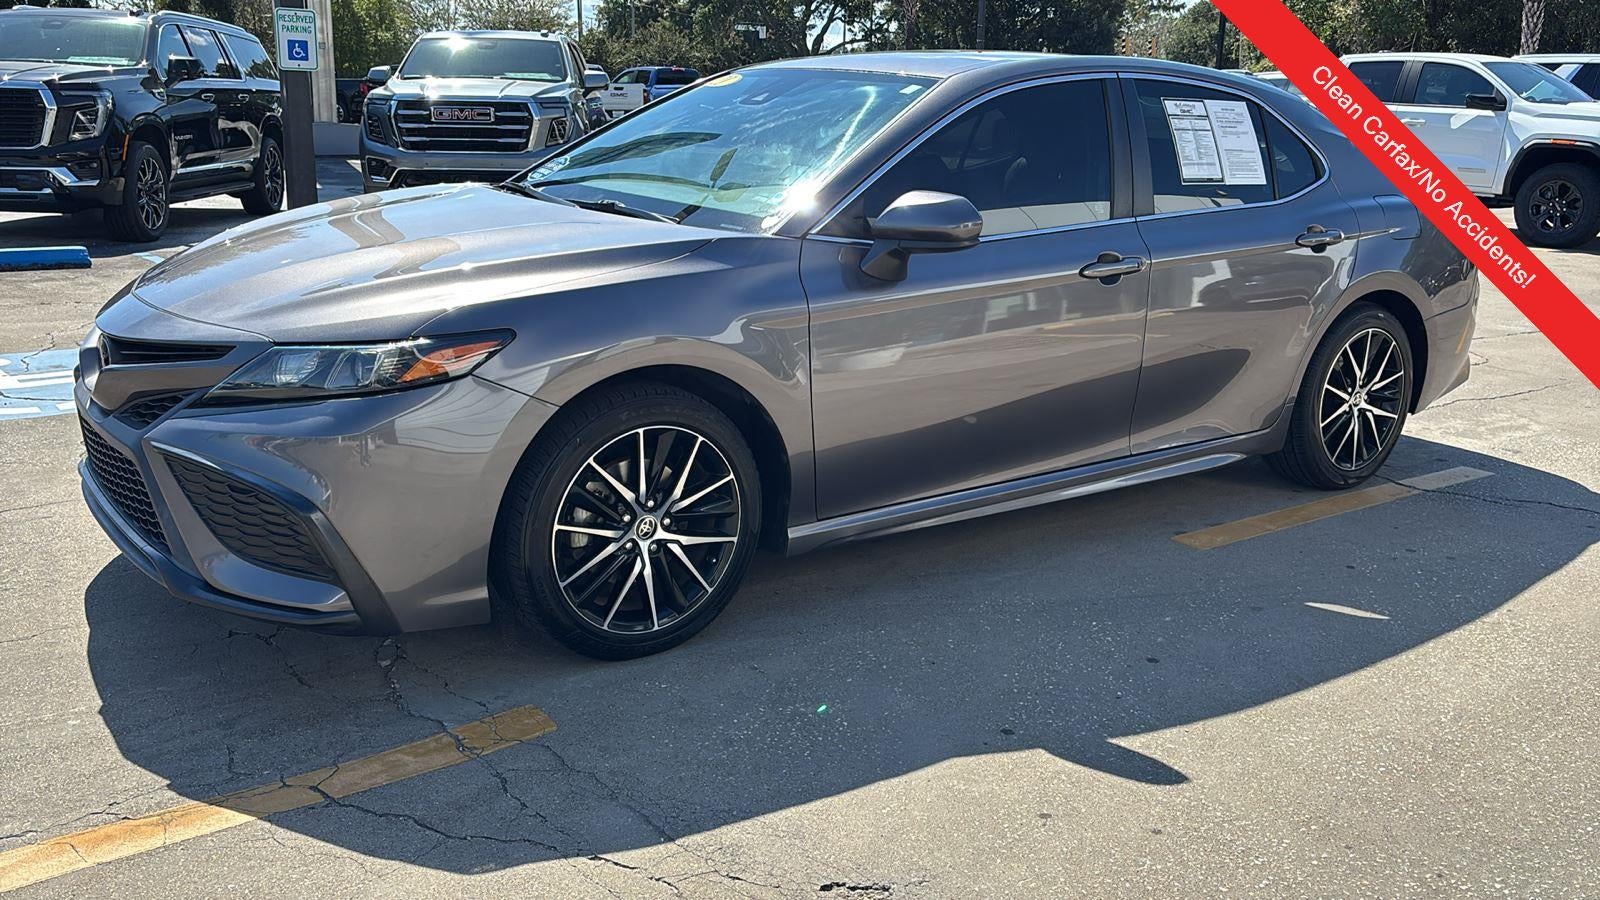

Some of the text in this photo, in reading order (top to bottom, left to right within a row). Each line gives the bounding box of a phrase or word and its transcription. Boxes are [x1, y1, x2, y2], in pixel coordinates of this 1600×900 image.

[278, 14, 314, 24] RESERVED
[281, 24, 312, 34] PARKING
[433, 108, 490, 120] GMC
